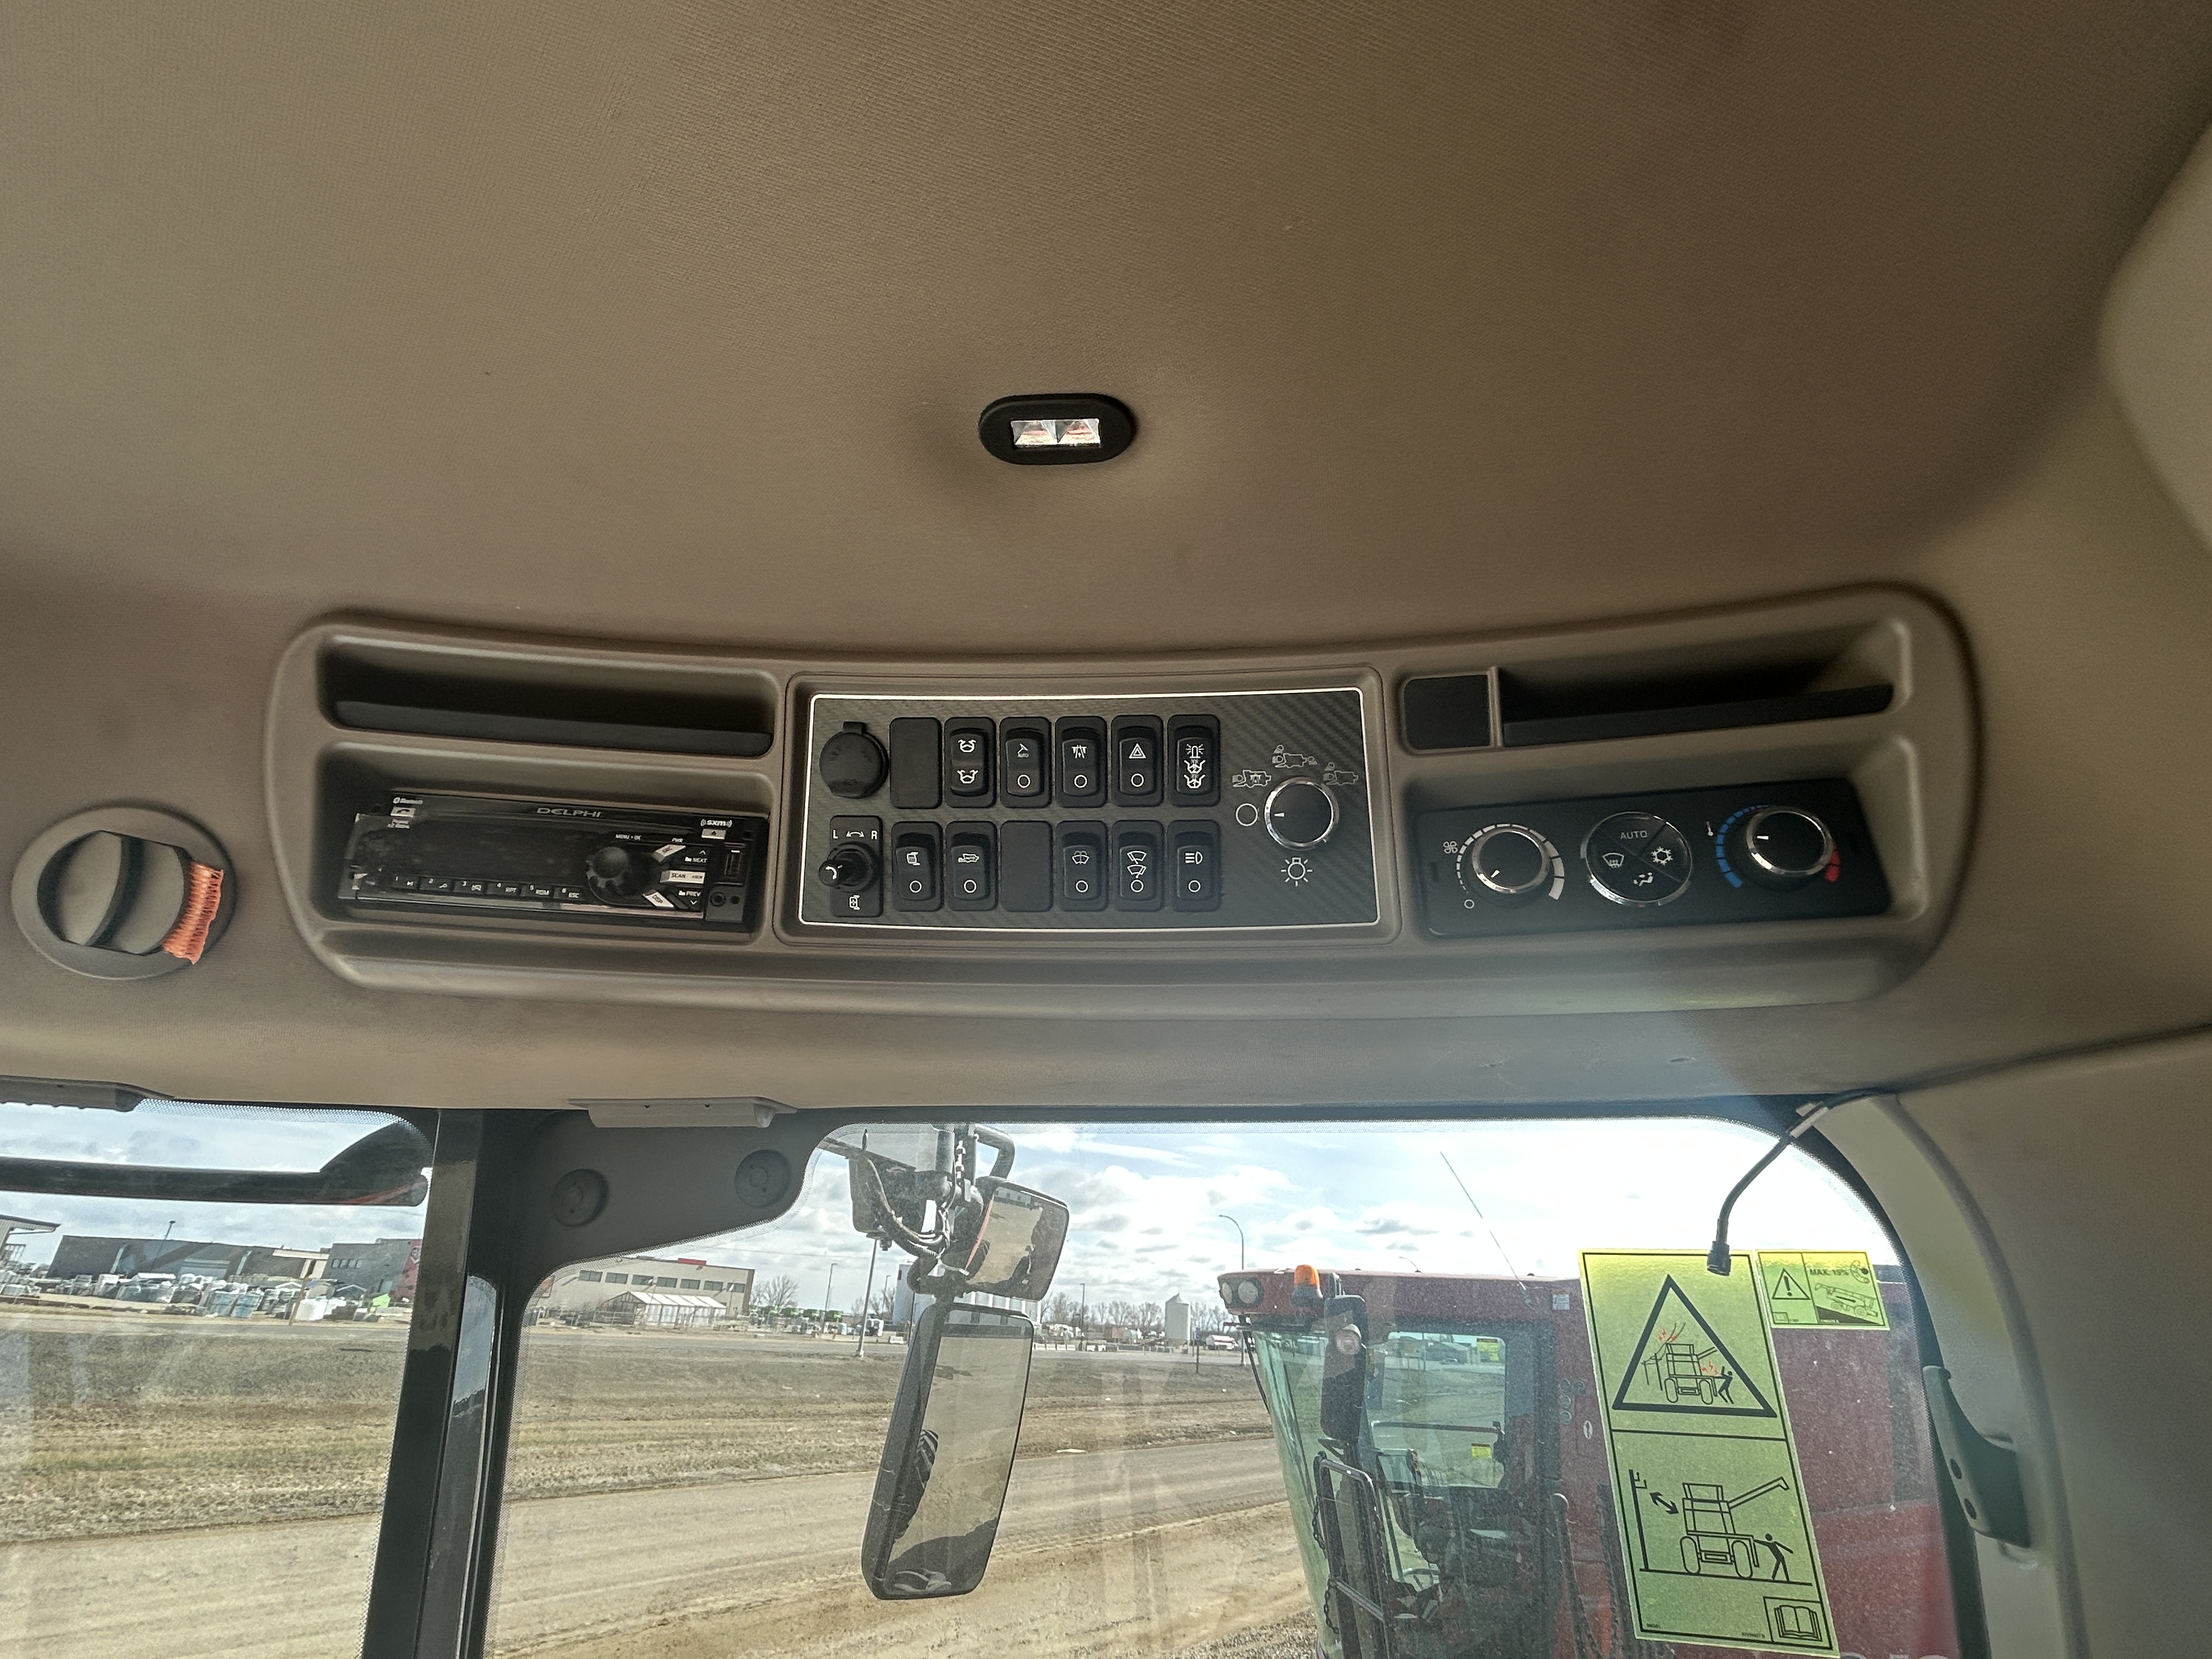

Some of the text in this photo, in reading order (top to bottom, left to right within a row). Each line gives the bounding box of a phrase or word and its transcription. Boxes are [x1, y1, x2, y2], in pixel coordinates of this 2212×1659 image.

[537, 808, 601, 817] DELPHI
[833, 830, 878, 840] L R
[1620, 830, 1648, 840] AUTO
